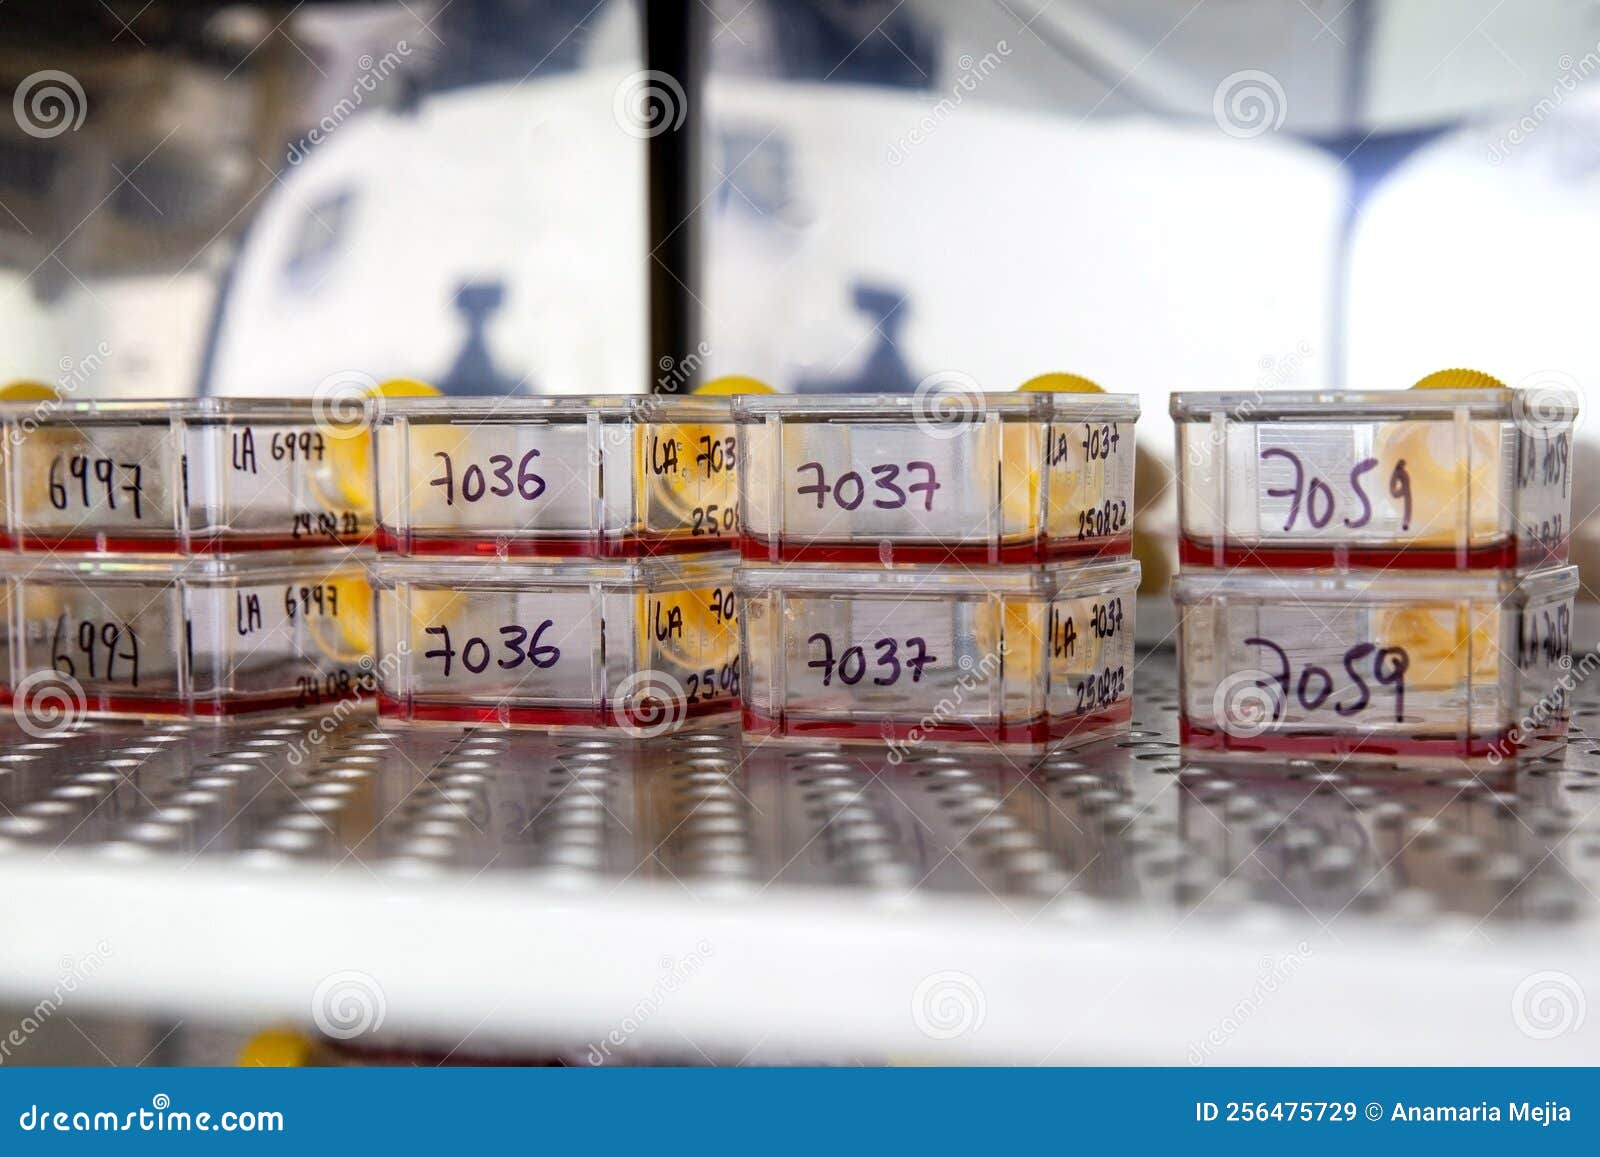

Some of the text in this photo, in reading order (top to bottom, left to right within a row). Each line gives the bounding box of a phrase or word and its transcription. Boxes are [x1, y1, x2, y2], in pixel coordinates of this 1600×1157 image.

[234, 427, 326, 474] LA 6997
[653, 435, 736, 479] LA 703
[1052, 421, 1119, 466] LA 7037
[49, 456, 142, 519] 6997
[430, 449, 546, 505] 7036
[797, 461, 941, 511] 7037
[1261, 448, 1413, 531] 7059
[237, 586, 338, 635] LA 6997
[656, 588, 739, 641] LA 70
[1054, 597, 1123, 658] LA 7037
[425, 620, 560, 676] 7036
[807, 632, 937, 686] 7037
[1244, 637, 1409, 722] 7059
